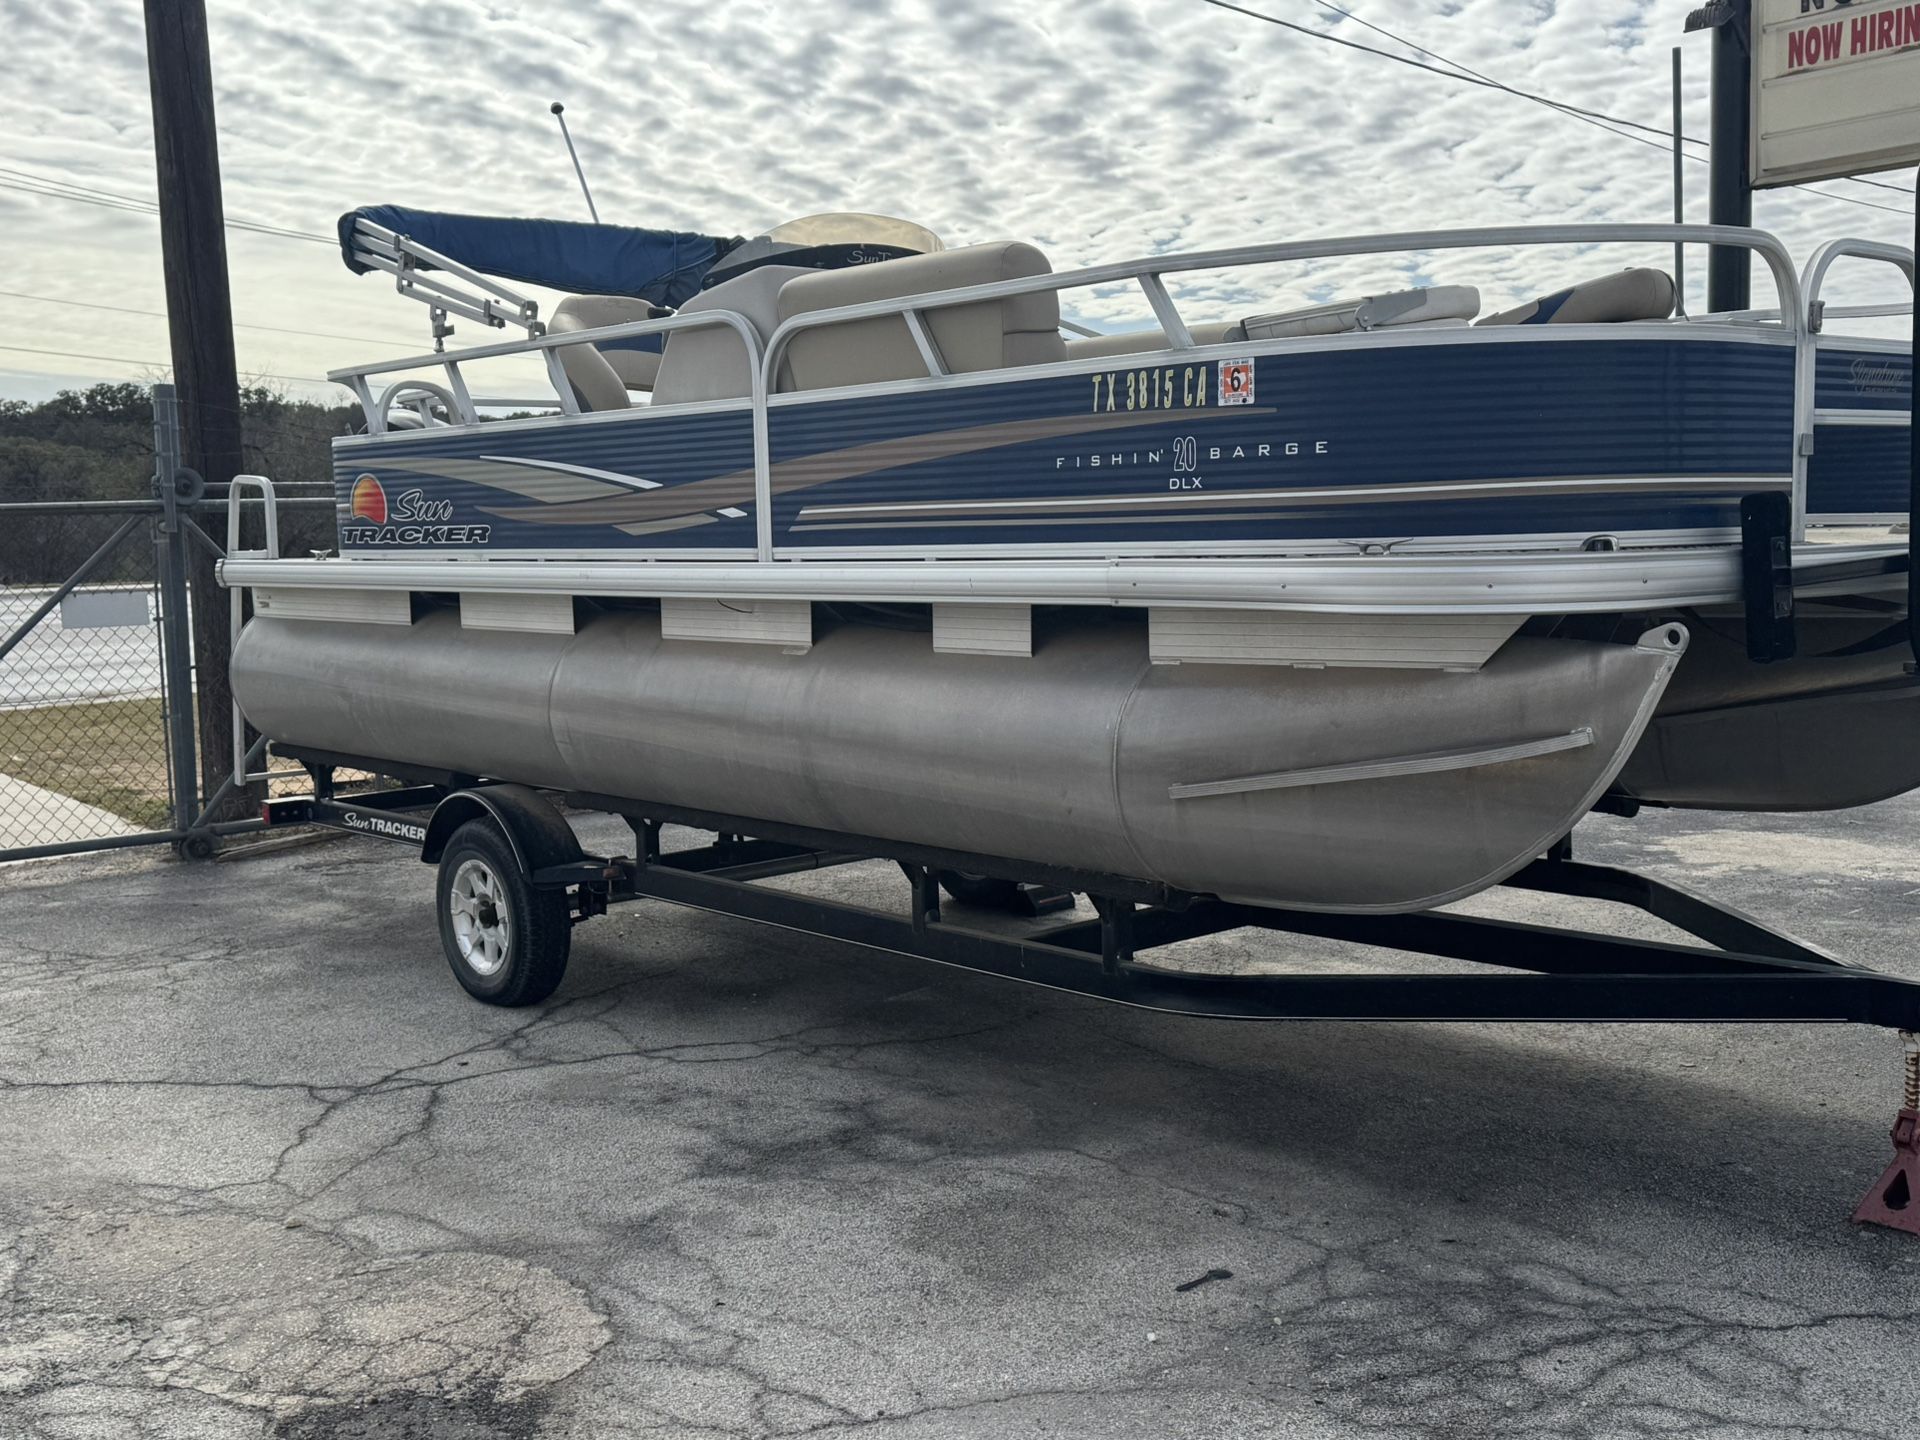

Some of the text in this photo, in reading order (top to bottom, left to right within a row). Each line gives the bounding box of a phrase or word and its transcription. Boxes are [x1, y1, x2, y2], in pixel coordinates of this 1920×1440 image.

[1788, 3, 1920, 69] NOW HIRIN
[1092, 373, 1116, 412] TX
[1126, 368, 1174, 411] 3815
[1183, 366, 1207, 407] CA
[1231, 367, 1241, 392] 6
[1056, 436, 1328, 472] FISHIN' 20 BARGE
[1169, 477, 1203, 490] DLX
[390, 488, 453, 521] Sun
[342, 524, 491, 545] TRACKER
